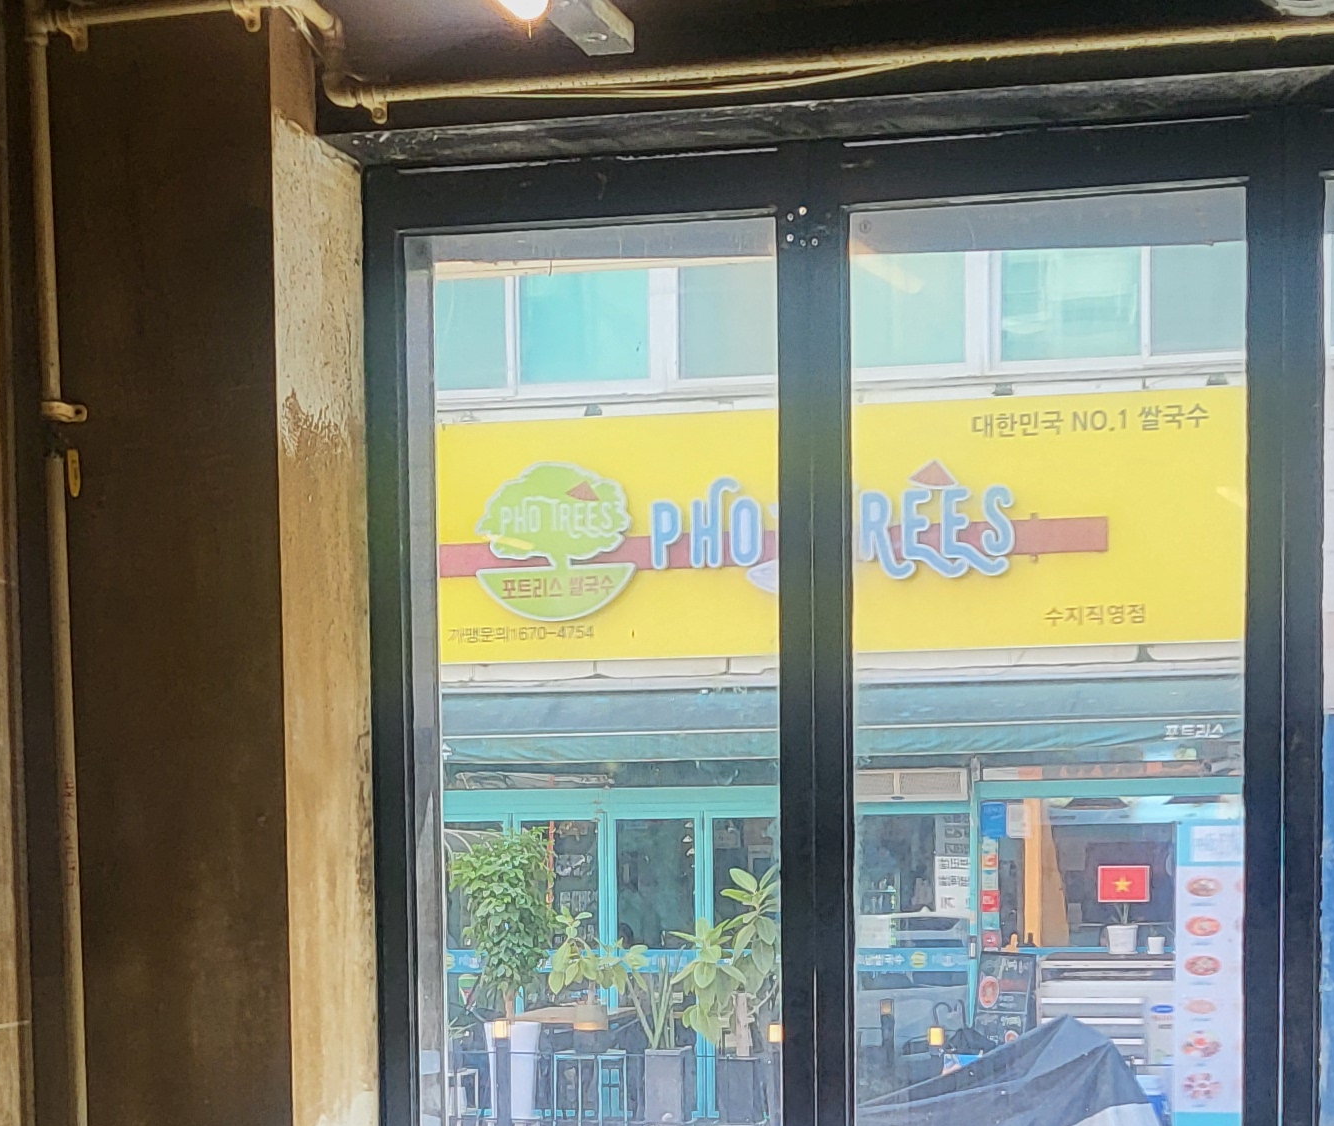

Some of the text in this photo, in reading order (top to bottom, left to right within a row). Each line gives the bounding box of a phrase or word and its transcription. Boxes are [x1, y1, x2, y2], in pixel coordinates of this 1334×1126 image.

[971, 402, 1211, 438] 대한민국 NO.1 쌀국수
[499, 495, 617, 538] PHO TREES
[650, 476, 1017, 579] PHO REES
[500, 574, 616, 600] 포트리스 쌀국수
[1042, 602, 1148, 627] 수지직영점
[1163, 722, 1225, 742] 포트리스
